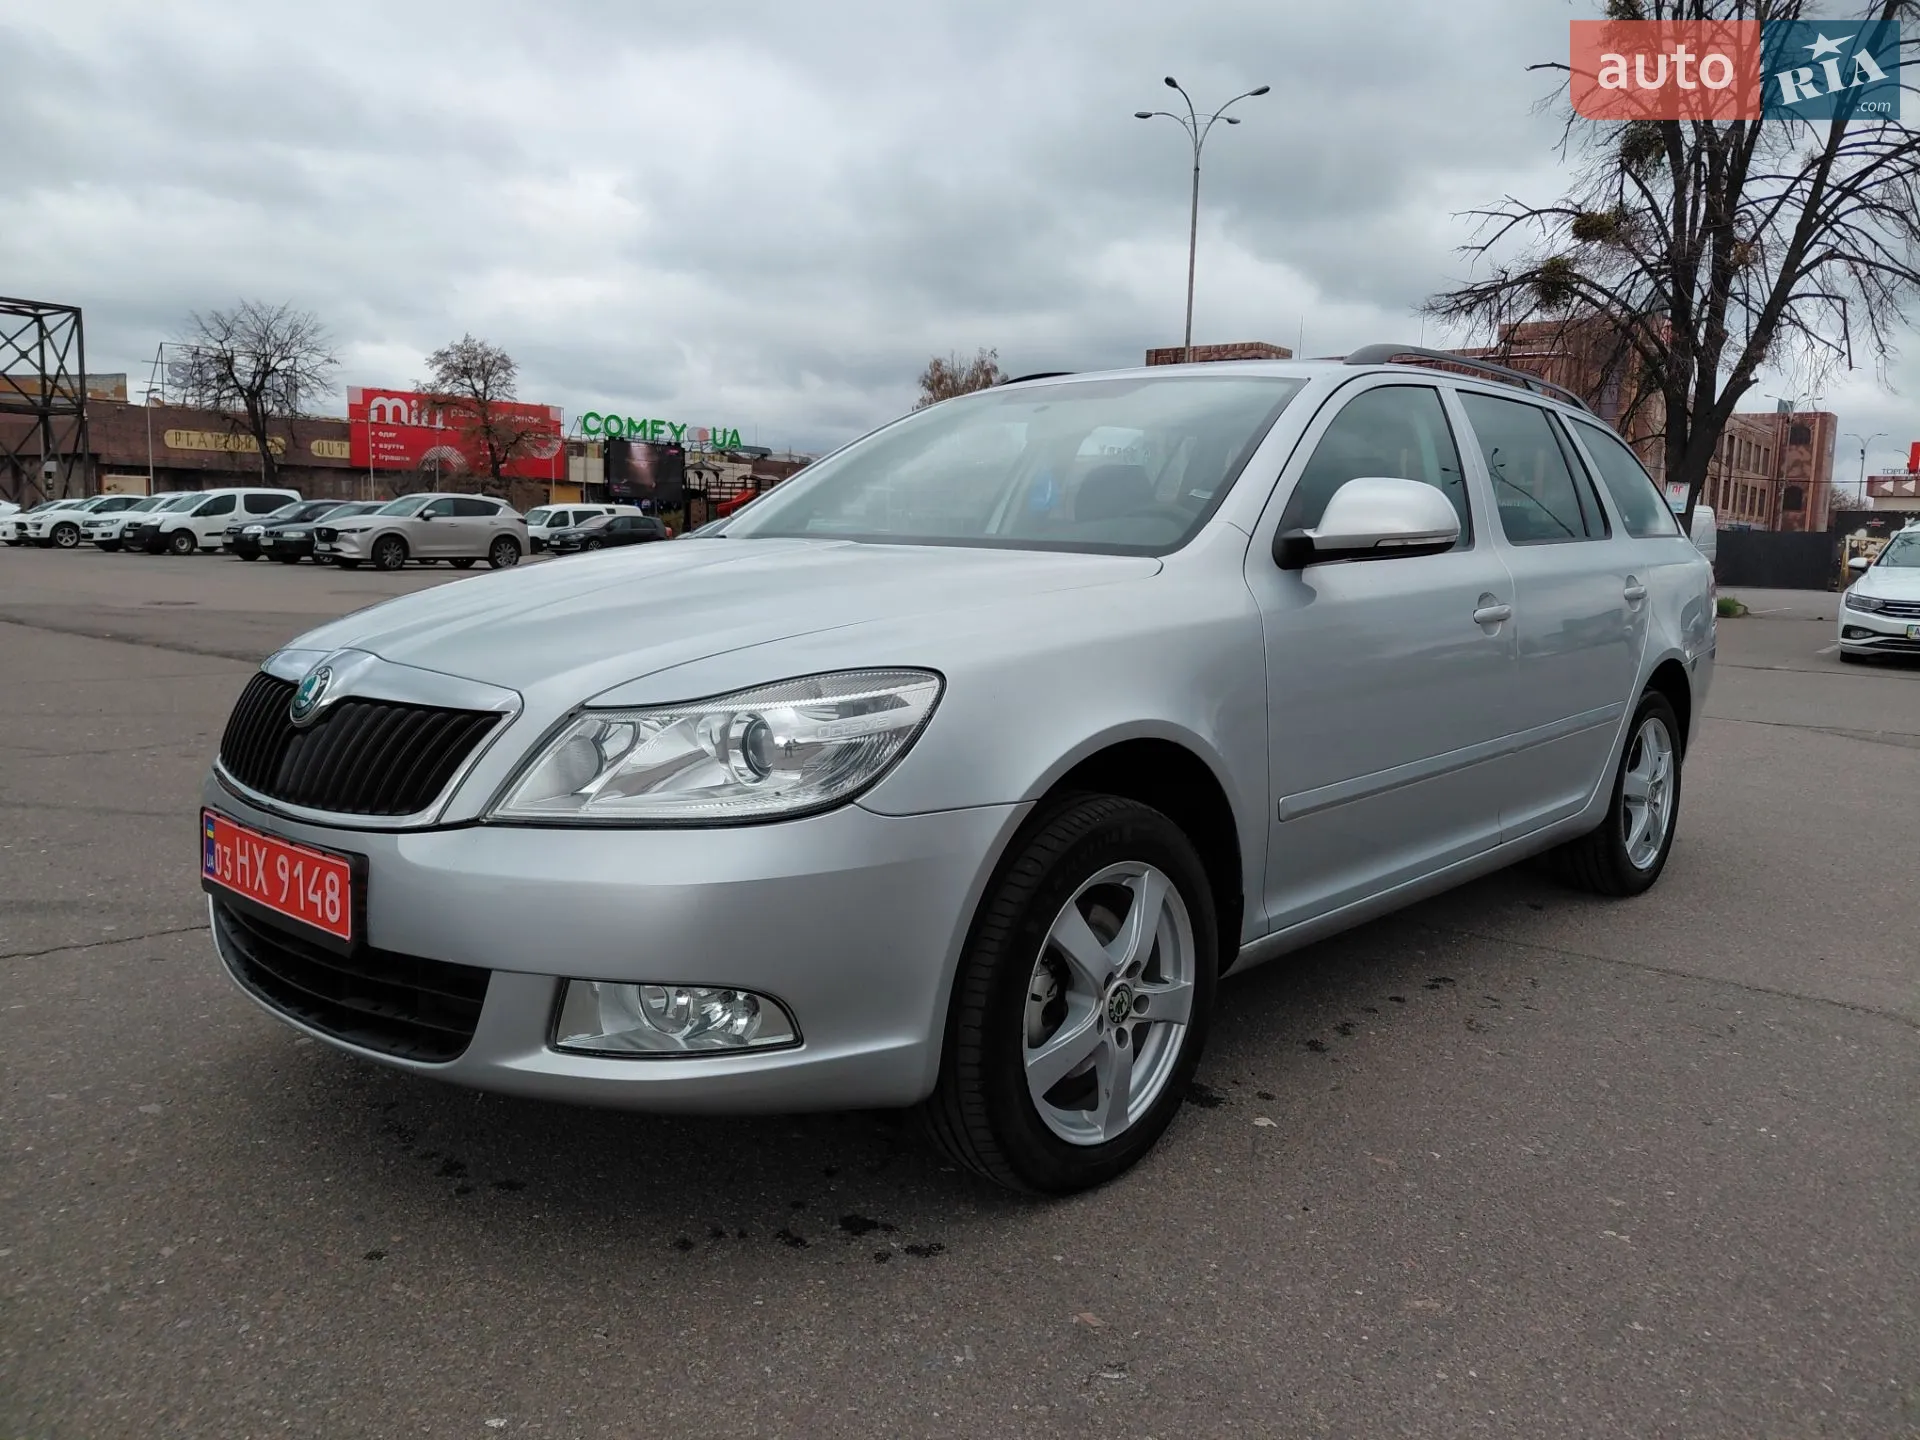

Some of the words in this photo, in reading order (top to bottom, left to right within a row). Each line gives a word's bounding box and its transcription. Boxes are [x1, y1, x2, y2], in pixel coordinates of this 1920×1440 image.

[582, 411, 687, 442] COMFY
[712, 427, 742, 449] UA
[215, 843, 232, 881] 03
[236, 836, 269, 896] HX
[276, 854, 341, 923] 9148
